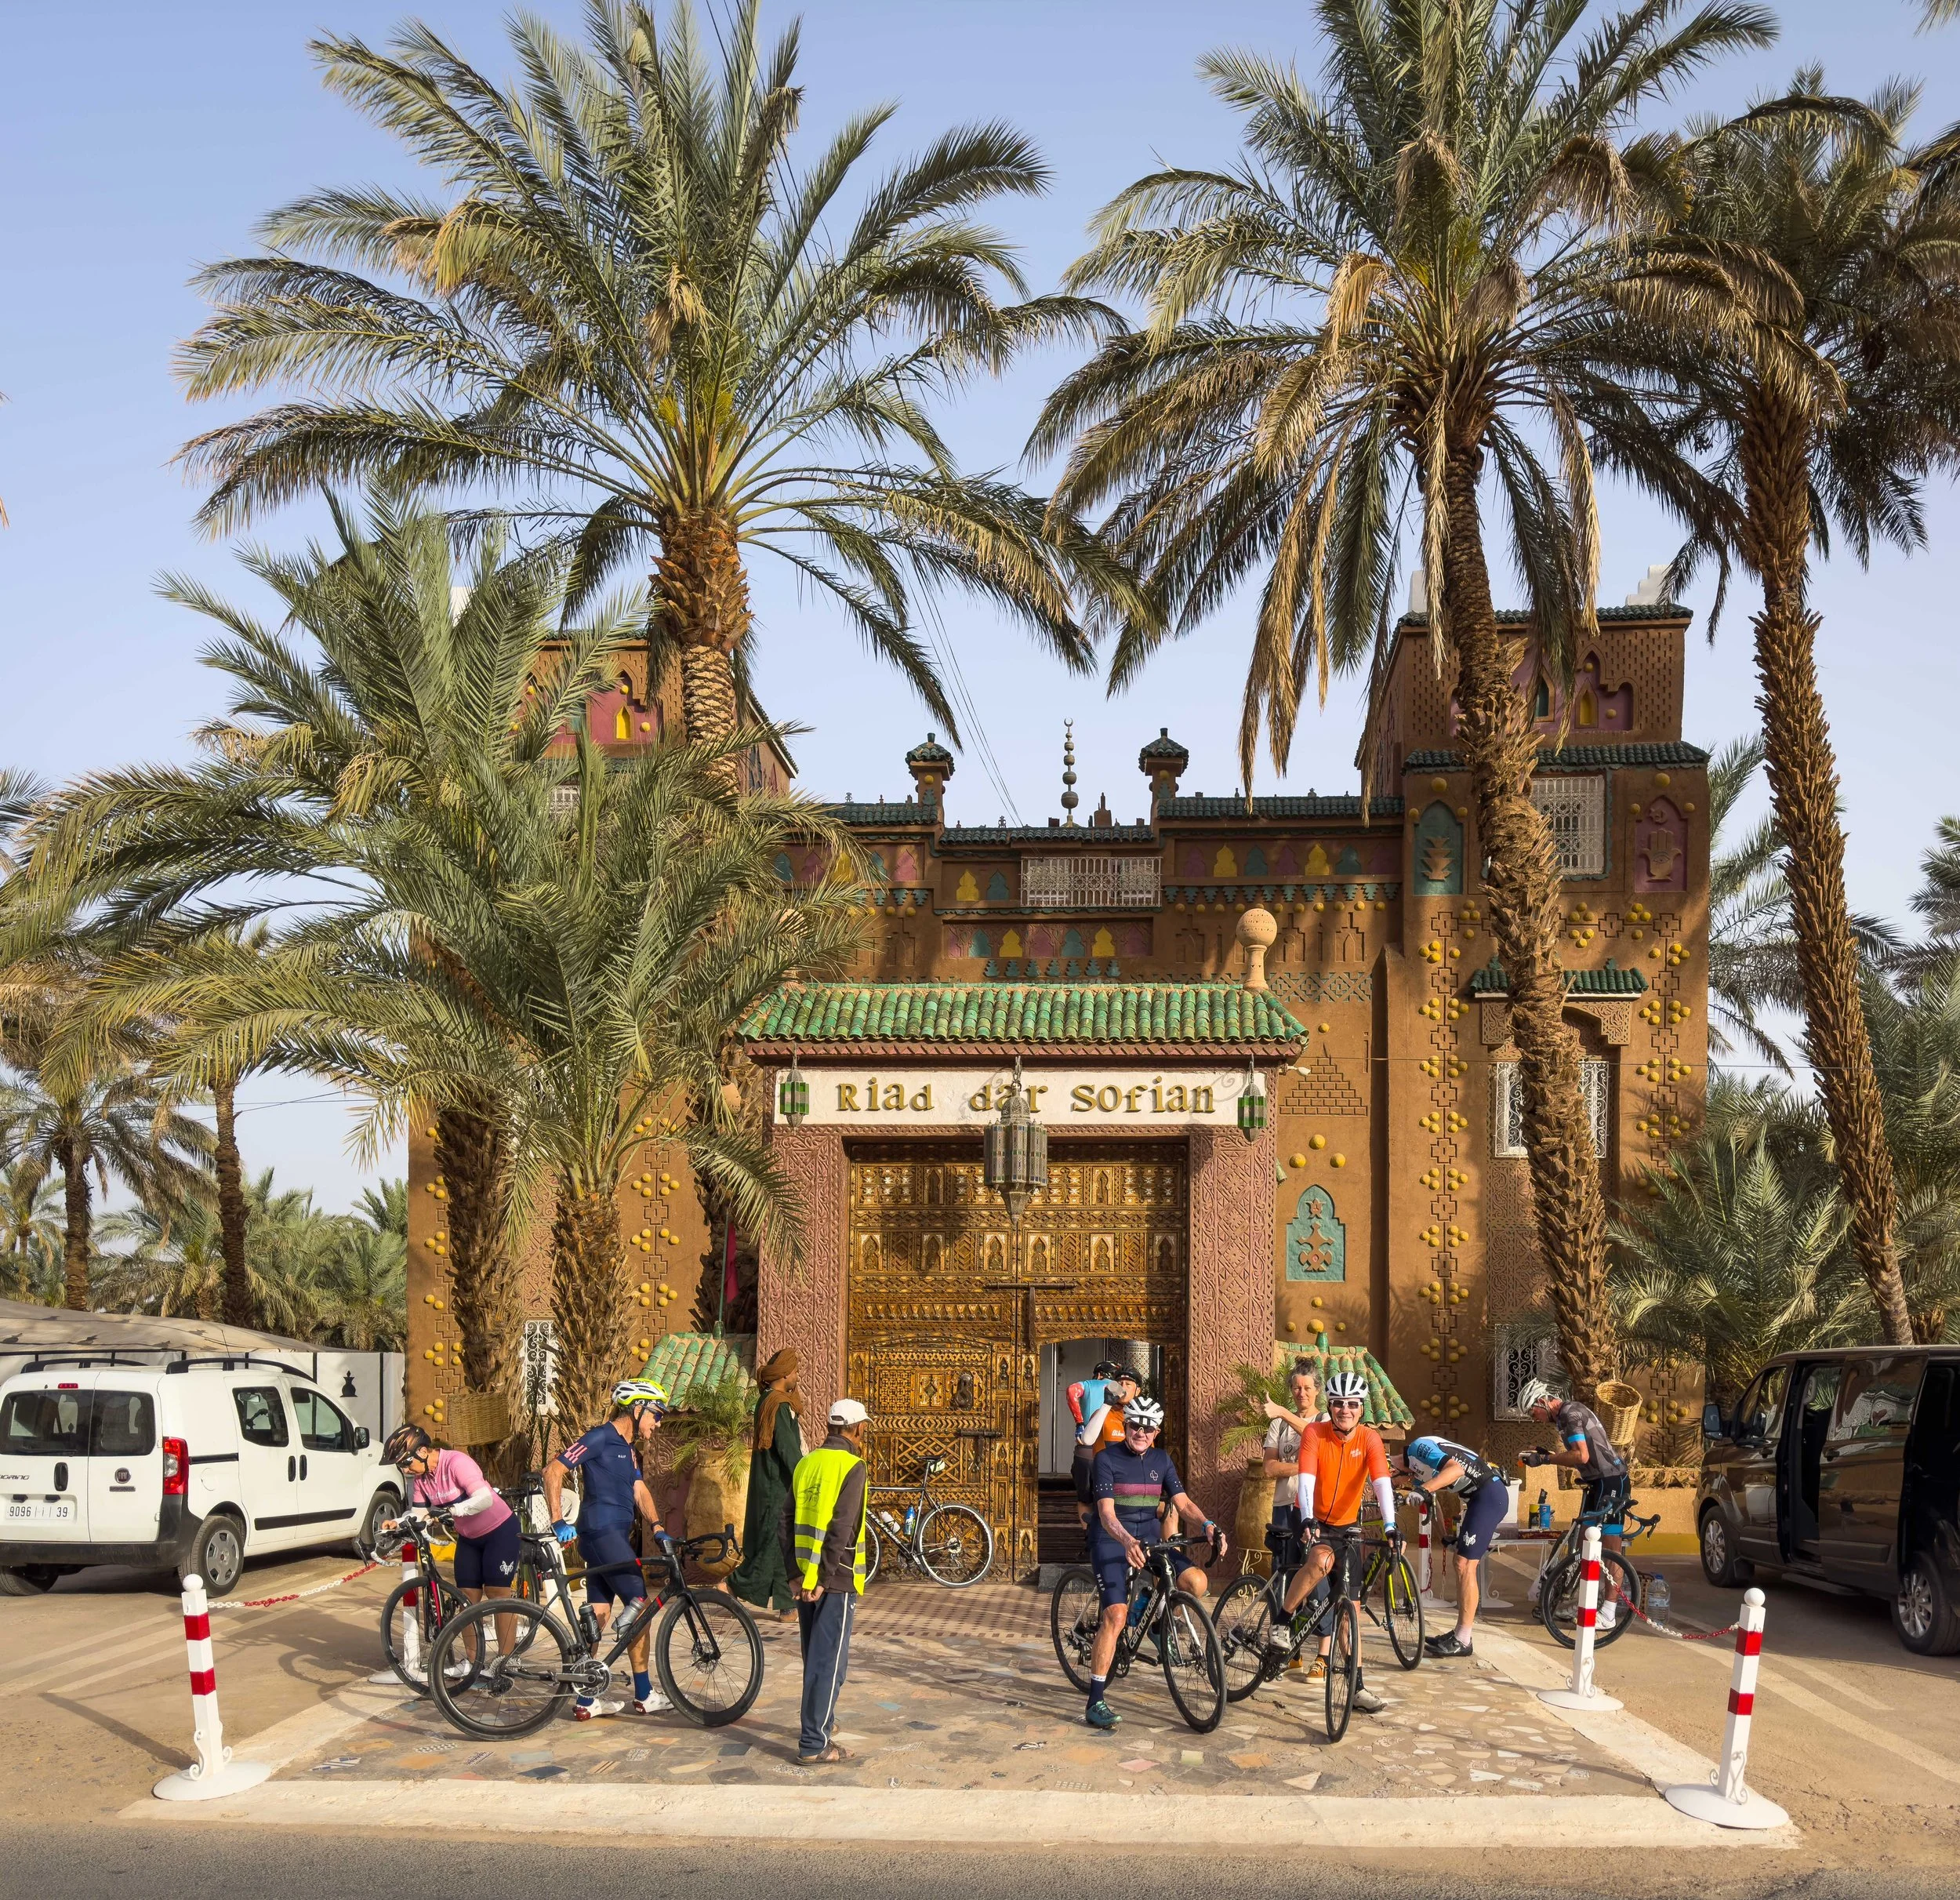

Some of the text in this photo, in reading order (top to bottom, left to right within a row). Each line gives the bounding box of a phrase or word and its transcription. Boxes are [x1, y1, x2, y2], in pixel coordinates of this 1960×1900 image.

[836, 1077, 935, 1111] Riad
[969, 1083, 1049, 1113] dar
[9, 1506, 31, 1517] 9096
[56, 1506, 68, 1517] 39
[1096, 1573, 1105, 1592] MAAP
[1129, 1589, 1160, 1649] cannondale
